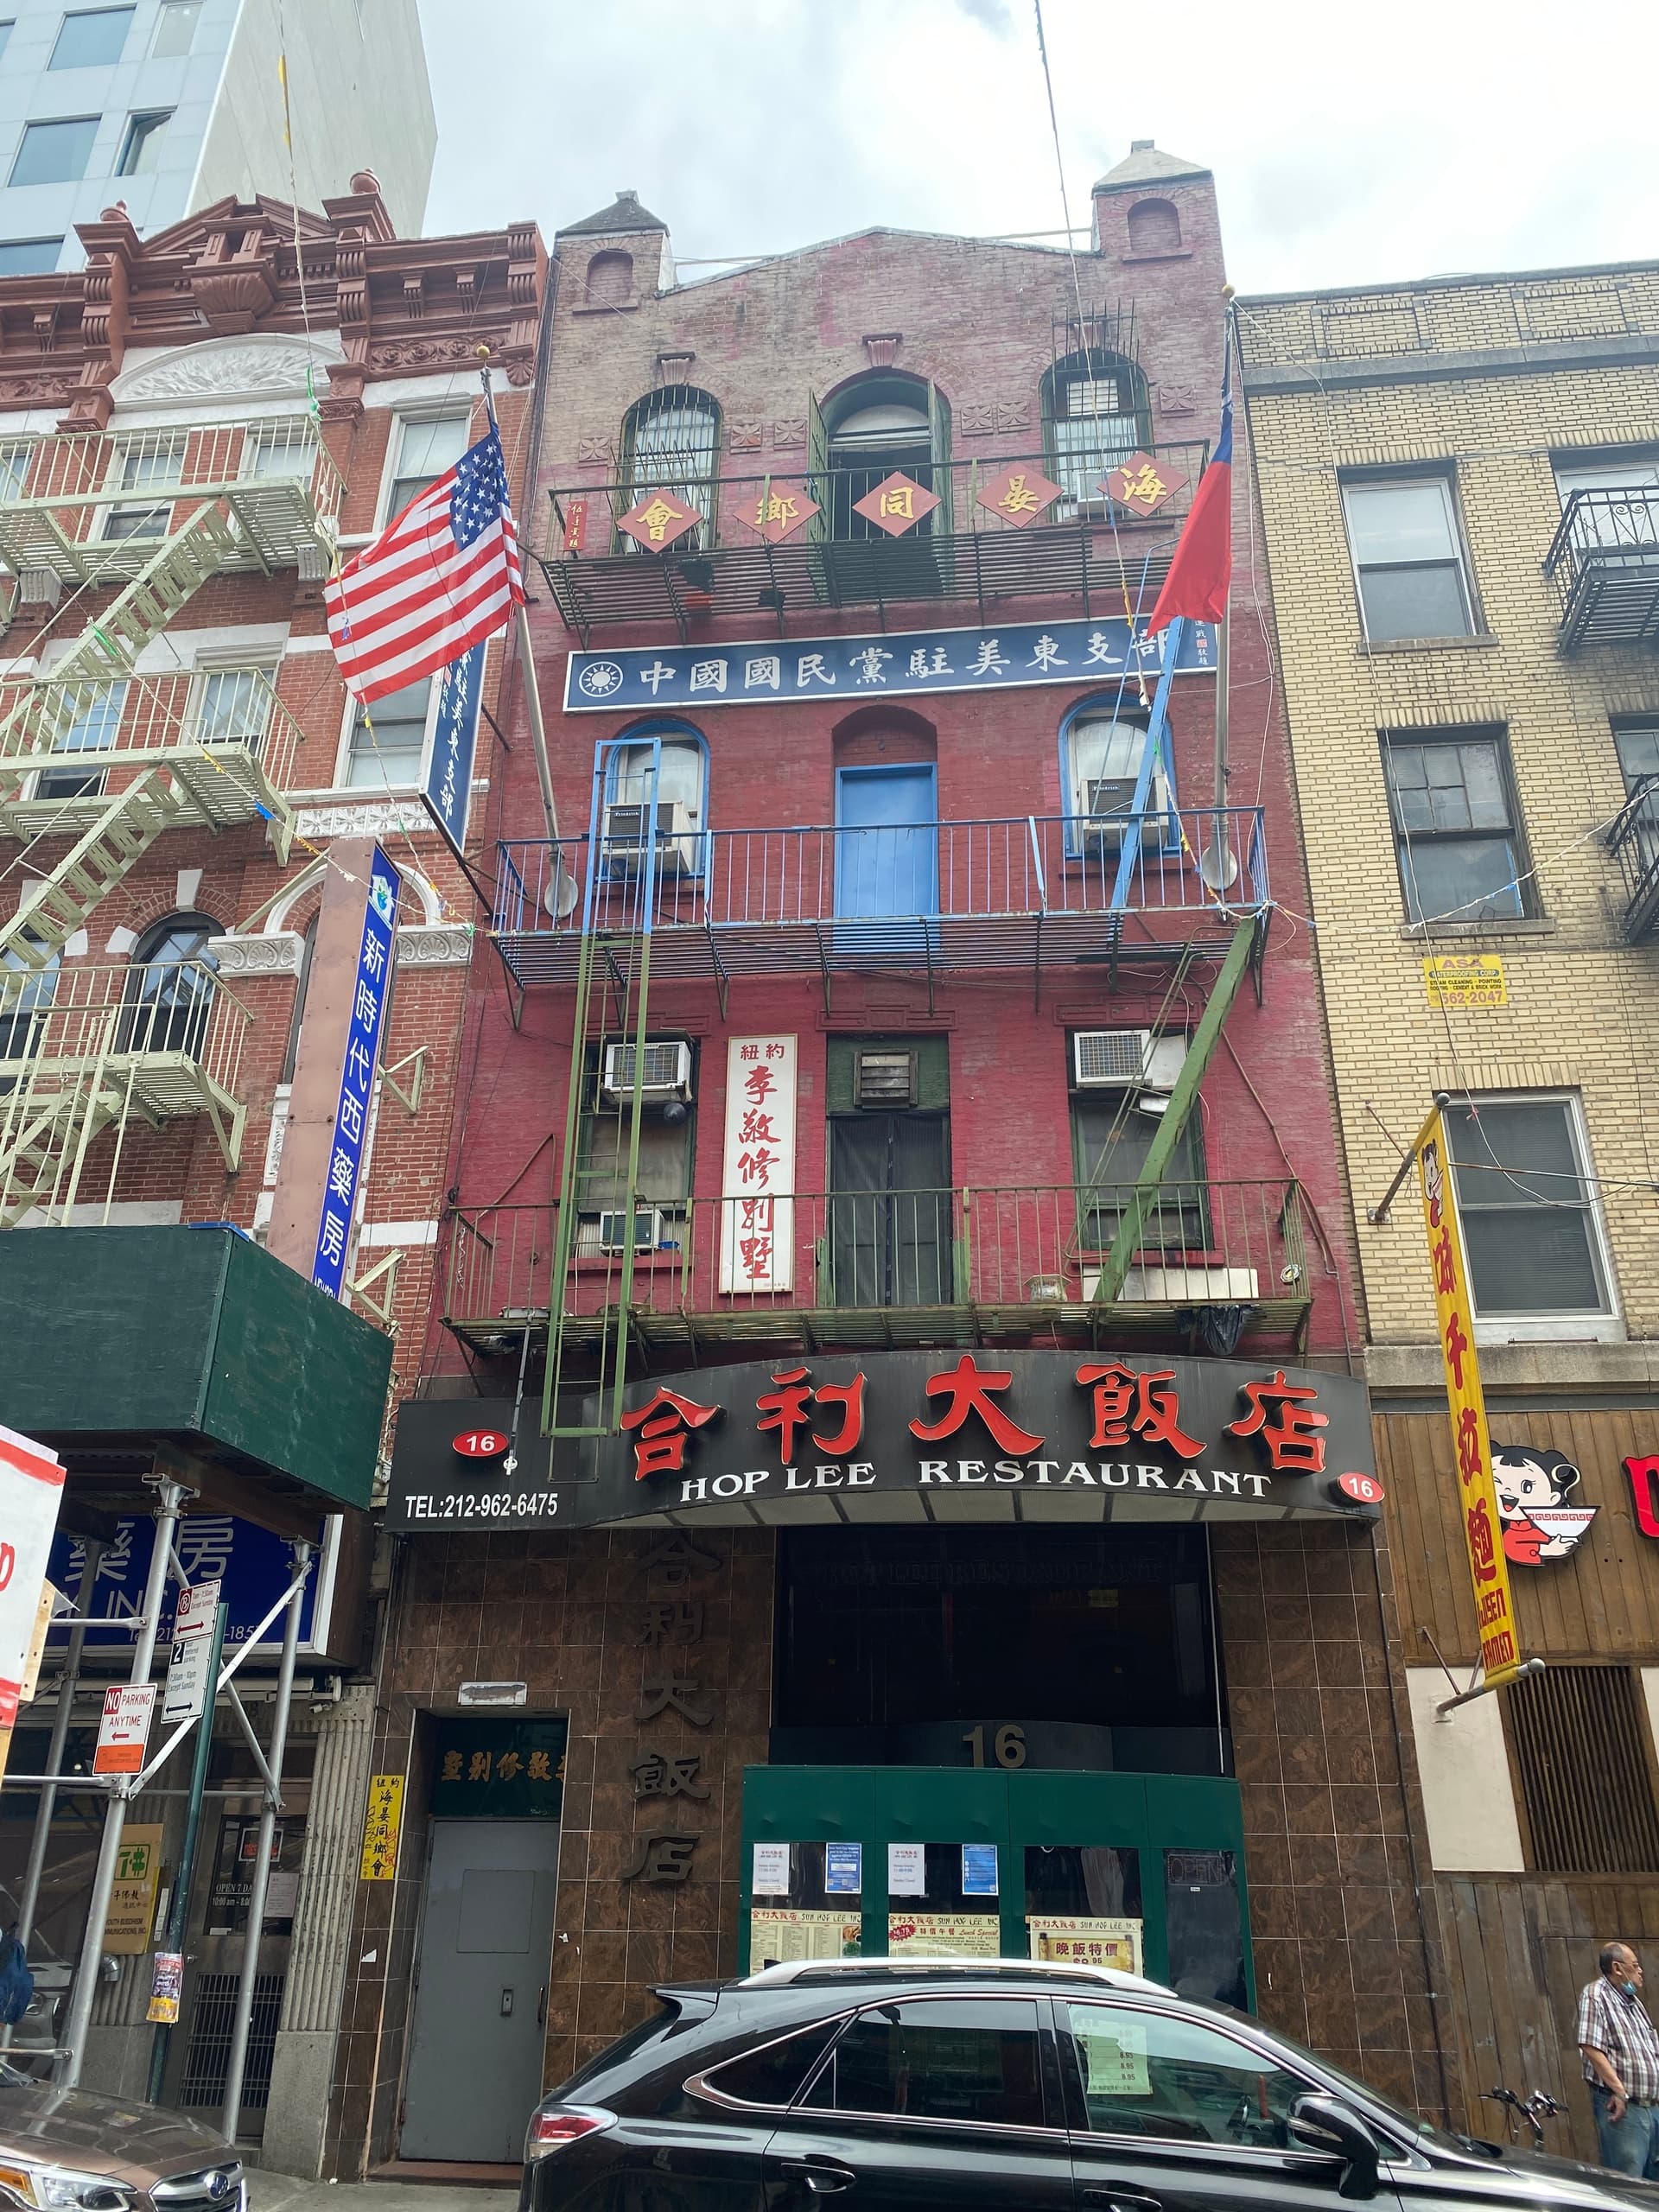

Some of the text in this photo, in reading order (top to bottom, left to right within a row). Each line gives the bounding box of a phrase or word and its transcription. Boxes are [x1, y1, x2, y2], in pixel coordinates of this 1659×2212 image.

[1441, 958, 1484, 969] ASA
[741, 1043, 785, 1060] 紐約
[320, 927, 387, 1268] 新時代西藥房
[620, 1353, 1330, 1481] 合利大飯店
[466, 1435, 496, 1452] 16
[680, 1459, 1273, 1503] HOP LEE RESTAURANT
[1348, 1477, 1374, 1498] 16
[405, 1492, 559, 1518] TEL:212-962-6475
[174, 1643, 182, 1662] 2
[105, 1691, 151, 1711] NO PARKING
[109, 1714, 143, 1727] ANYTIME
[962, 1725, 1026, 1769] 16
[215, 1884, 236, 1892] OPEN
[833, 1914, 846, 1923] LEE
[937, 1916, 950, 1925] SUN
[969, 1916, 982, 1926] LEE
[1109, 1922, 1122, 1930] LEE
[958, 1928, 999, 1938] Lunch Special
[1056, 1942, 1118, 1956] 晚飯特價
